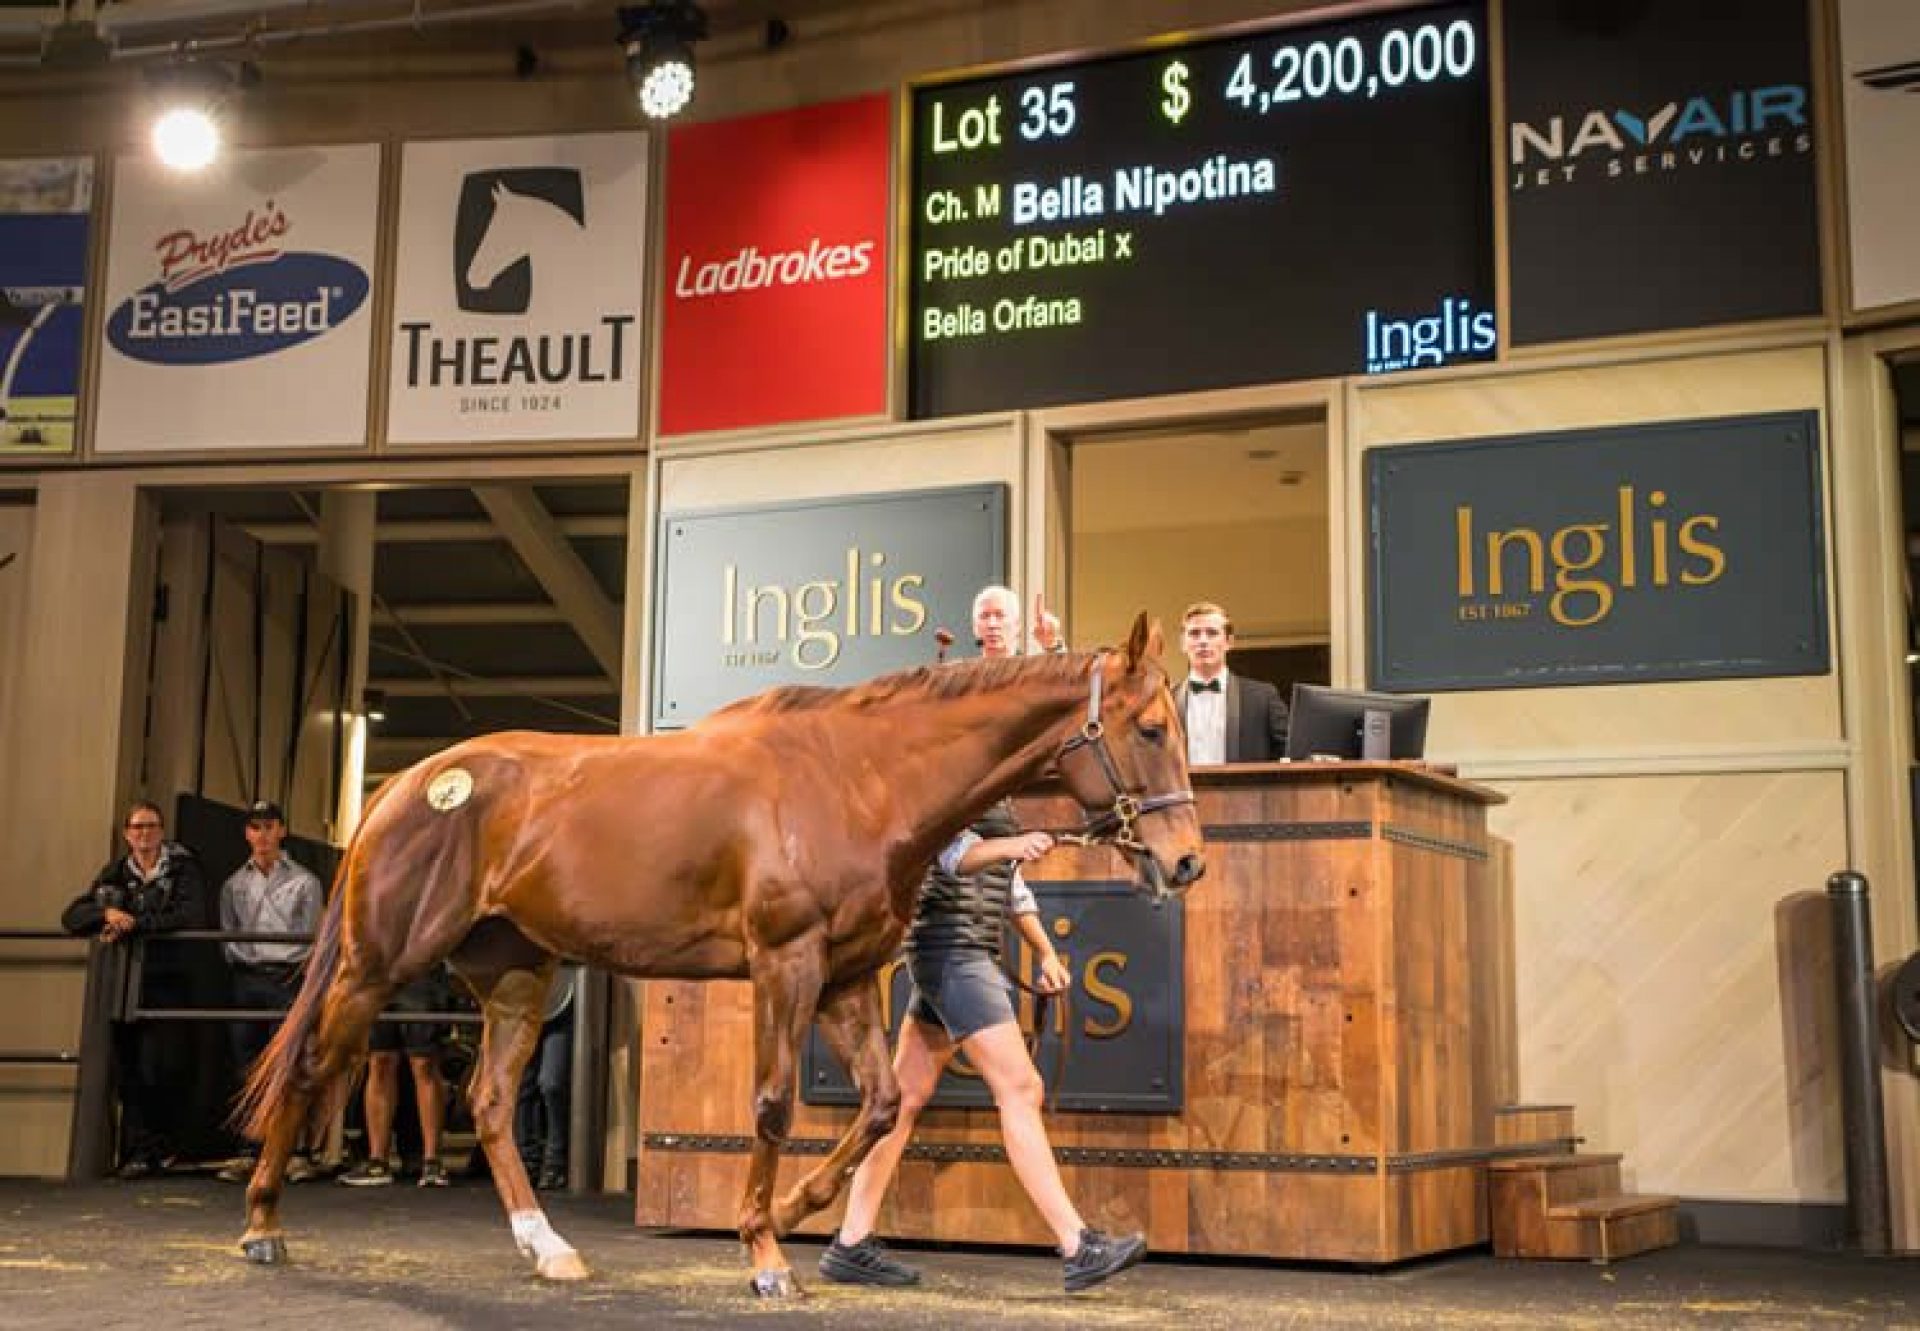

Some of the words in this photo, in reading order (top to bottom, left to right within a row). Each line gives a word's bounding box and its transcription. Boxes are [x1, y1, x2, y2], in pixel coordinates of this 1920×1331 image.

[933, 94, 1001, 153] Lot
[1020, 82, 1076, 140] 35
[1161, 61, 1191, 122] $
[1226, 20, 1475, 112] 4,200,000
[1512, 85, 1808, 165] NAVAIR
[926, 190, 968, 223] Ch.
[976, 183, 1000, 219] M
[1013, 174, 1104, 225] Bella
[1114, 154, 1276, 216] Nipotina
[1514, 165, 1576, 189] JET
[1607, 135, 1812, 177] SERVICES
[676, 237, 873, 298] Ladbrokes
[924, 245, 991, 282] Pride
[996, 238, 1024, 274] of
[1028, 228, 1104, 269] Dubai
[1115, 232, 1132, 259] x
[401, 315, 634, 389] THEAULT
[924, 304, 986, 340] Bella
[993, 296, 1081, 331] Orfana
[1366, 297, 1496, 367] Inglis
[1457, 486, 1727, 627] Inglis
[721, 548, 927, 670] Inglis
